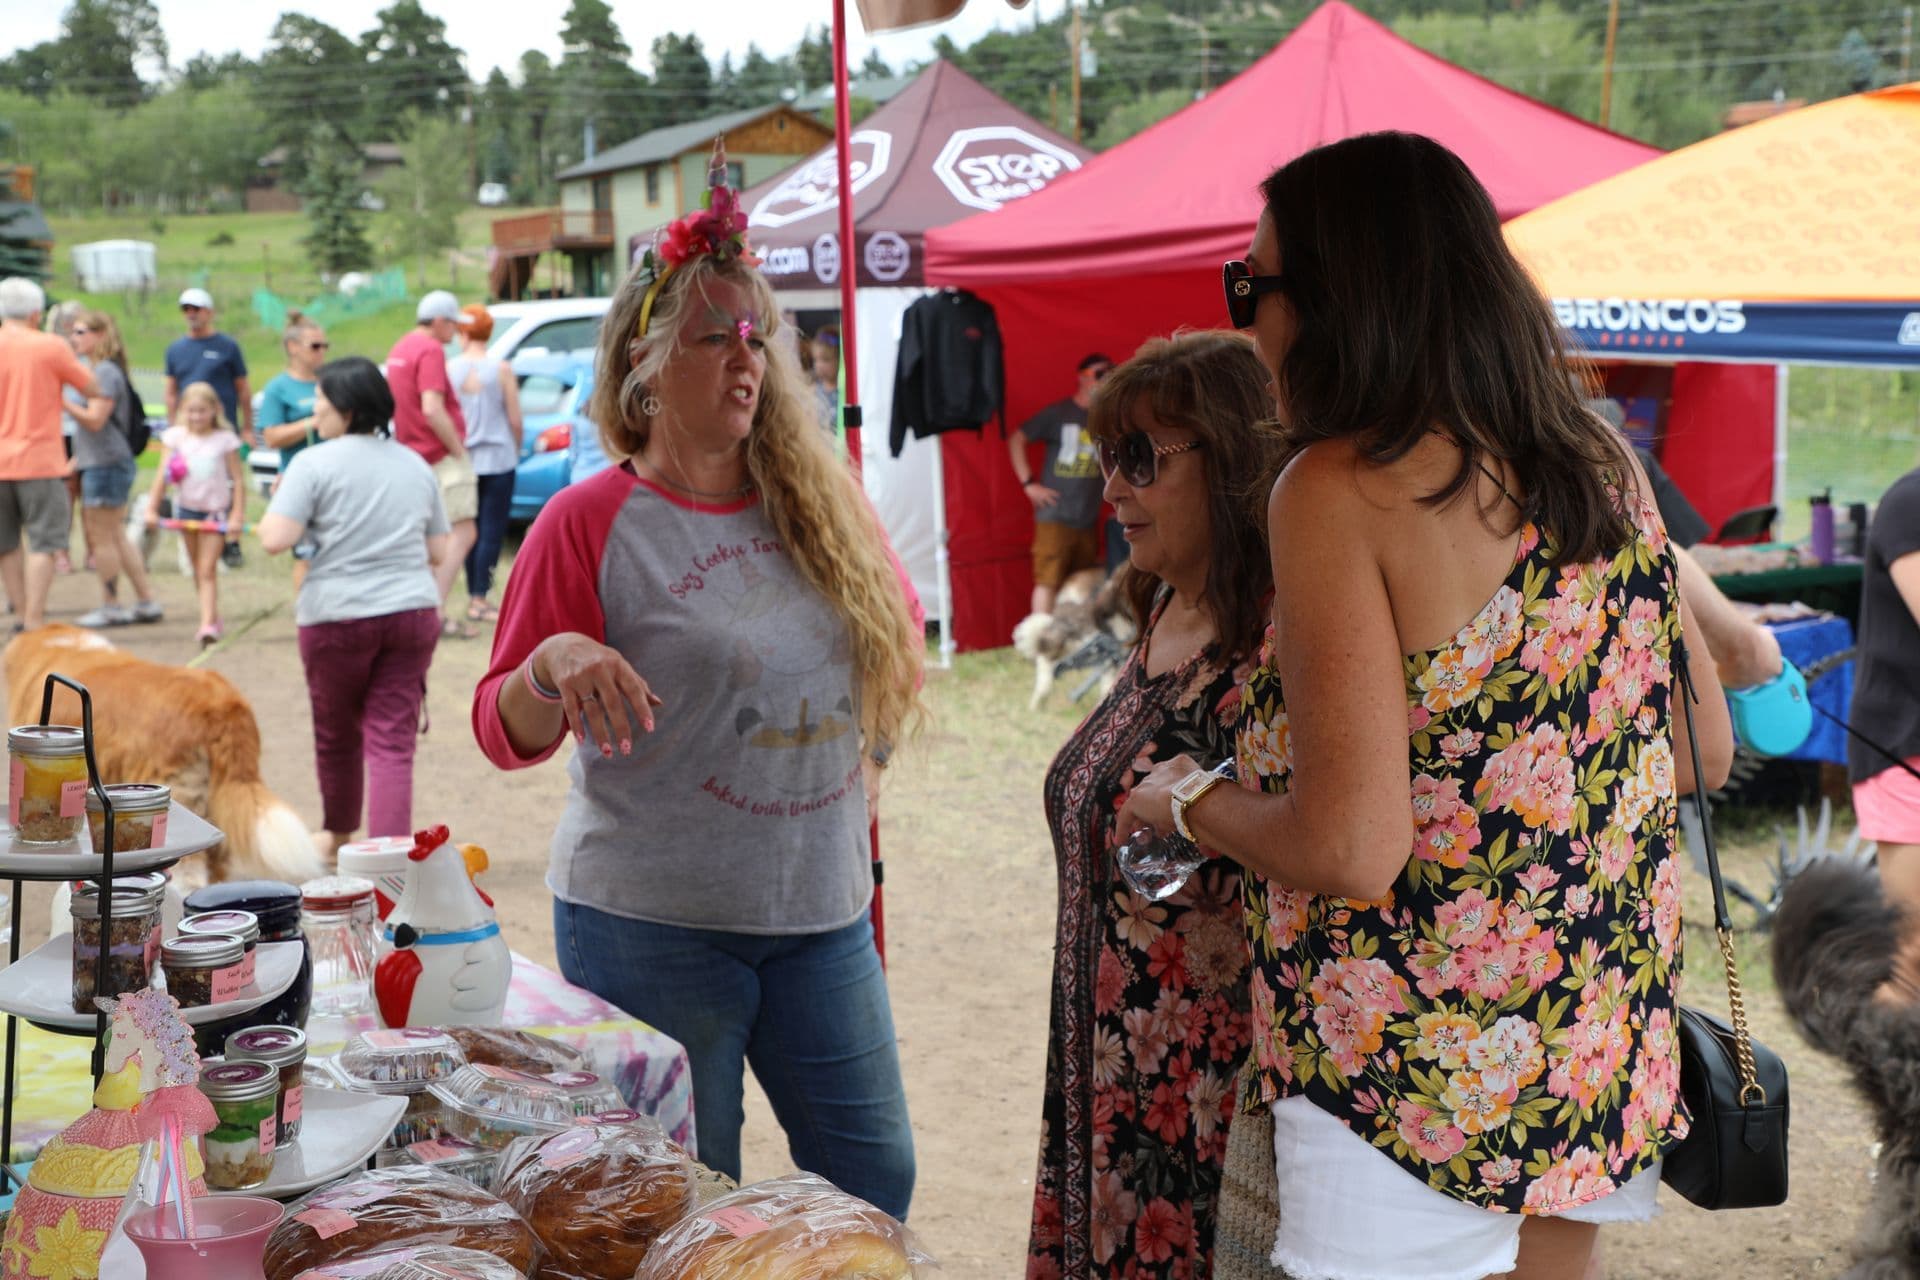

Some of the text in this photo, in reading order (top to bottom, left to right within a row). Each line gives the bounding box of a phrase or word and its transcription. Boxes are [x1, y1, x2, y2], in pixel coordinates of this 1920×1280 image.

[958, 152, 1061, 186] STOP
[1552, 297, 1746, 333] BRONCOS
[692, 543, 747, 573] Cookie
[750, 536, 782, 553] Jar
[700, 775, 847, 817] Baked with Unicorn
